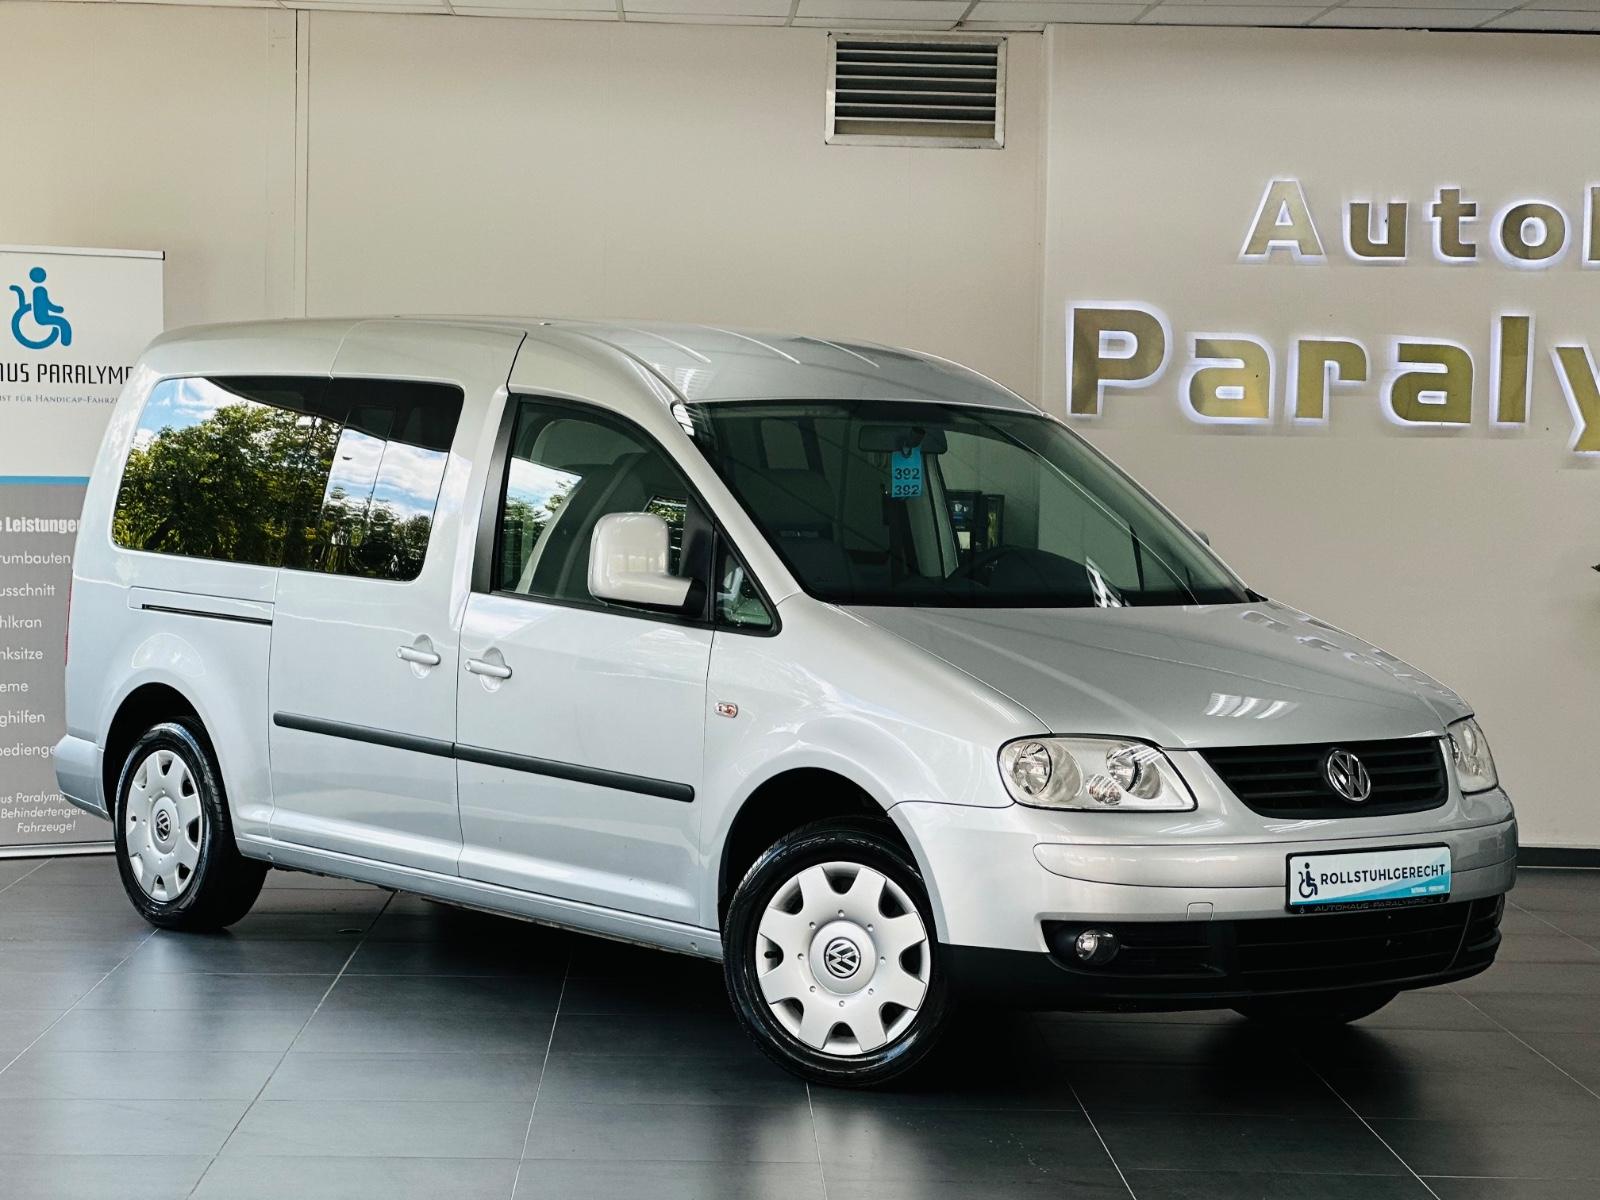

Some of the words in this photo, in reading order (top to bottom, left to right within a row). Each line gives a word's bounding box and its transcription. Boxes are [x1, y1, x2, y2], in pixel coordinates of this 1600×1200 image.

[1241, 179, 1600, 262] Auto
[894, 467, 920, 480] 392
[894, 484, 920, 496] 392
[0, 710, 45, 728] ghilfen
[1320, 863, 1446, 886] ROLLSTUHLGERECHT
